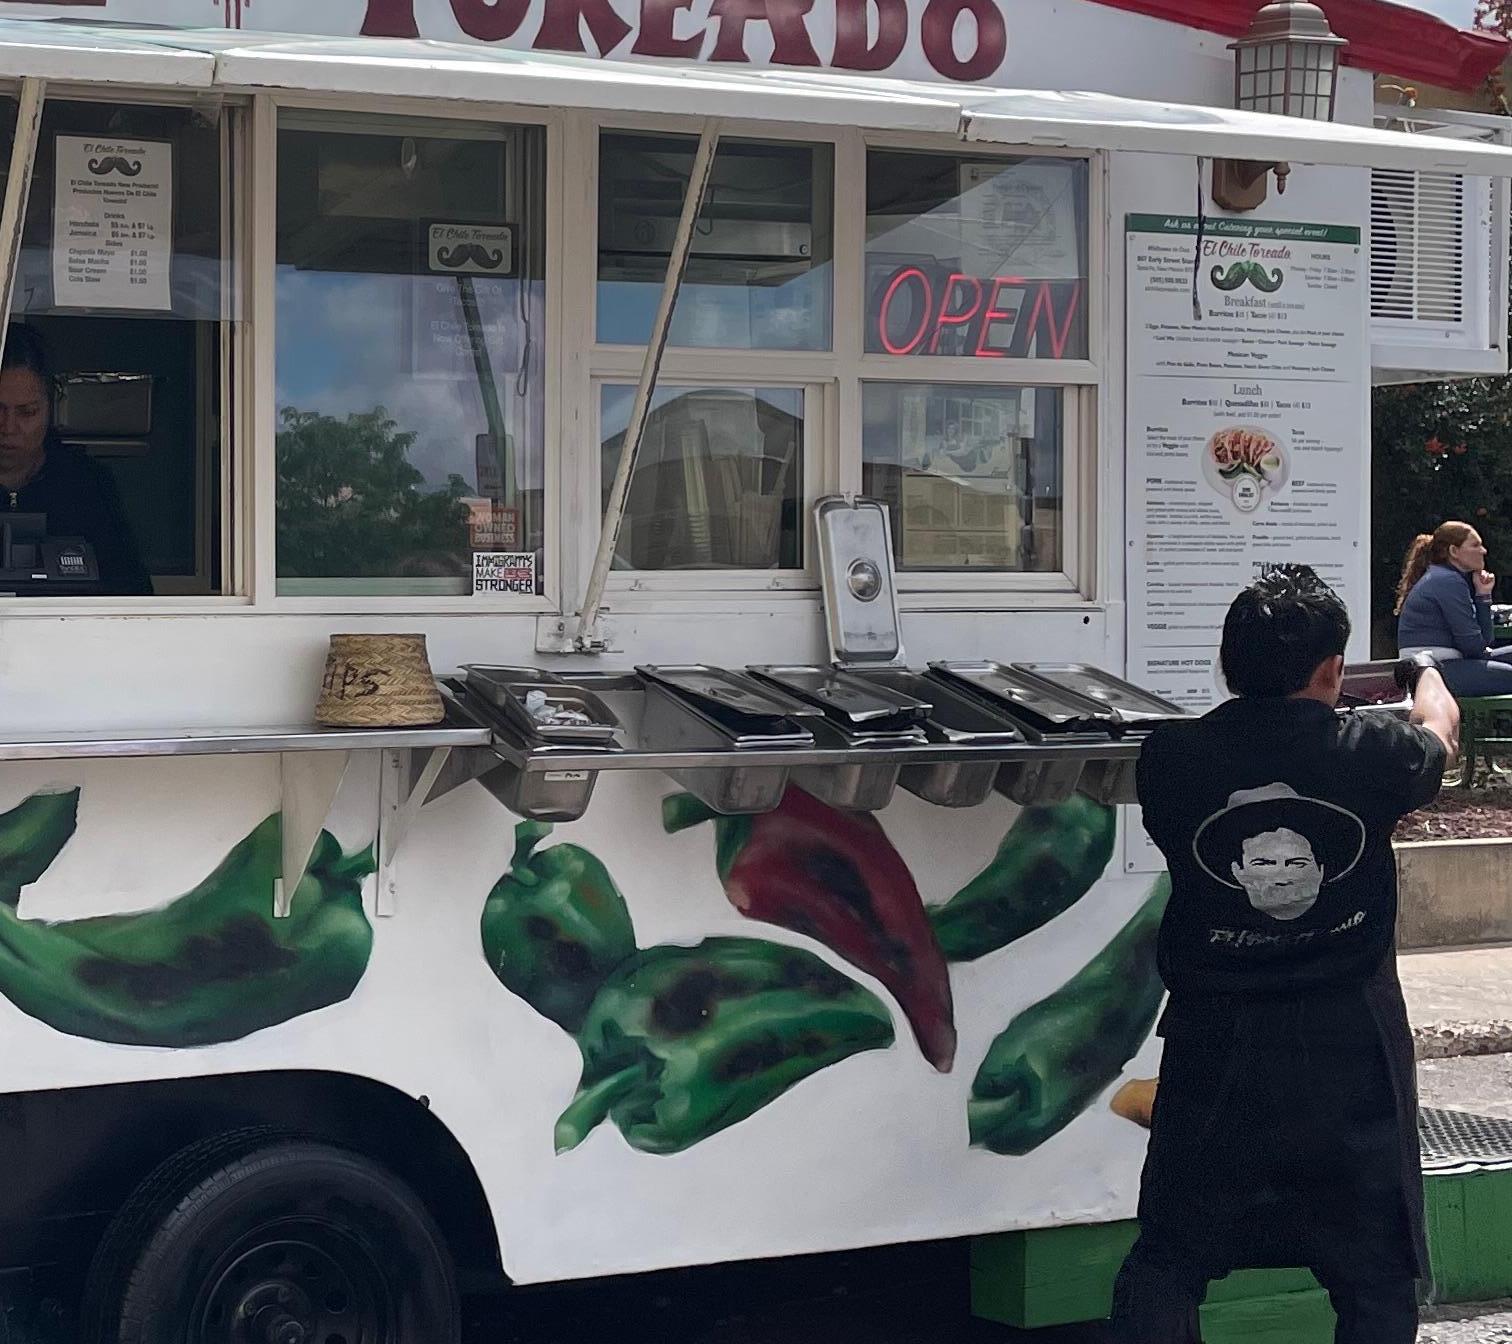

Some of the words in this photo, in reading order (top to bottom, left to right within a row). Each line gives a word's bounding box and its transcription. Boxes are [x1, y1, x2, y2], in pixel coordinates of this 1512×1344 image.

[432, 227, 444, 239] El
[1201, 240, 1217, 257] El
[1219, 240, 1247, 257] Chile
[1248, 242, 1292, 259] Toreado
[1224, 295, 1266, 308] Breakfast
[879, 268, 1080, 359] OPEN
[1233, 384, 1262, 396] Lunch
[474, 523, 516, 533] OWNED
[476, 567, 503, 578] MAKE
[475, 579, 533, 593] STRONGER
